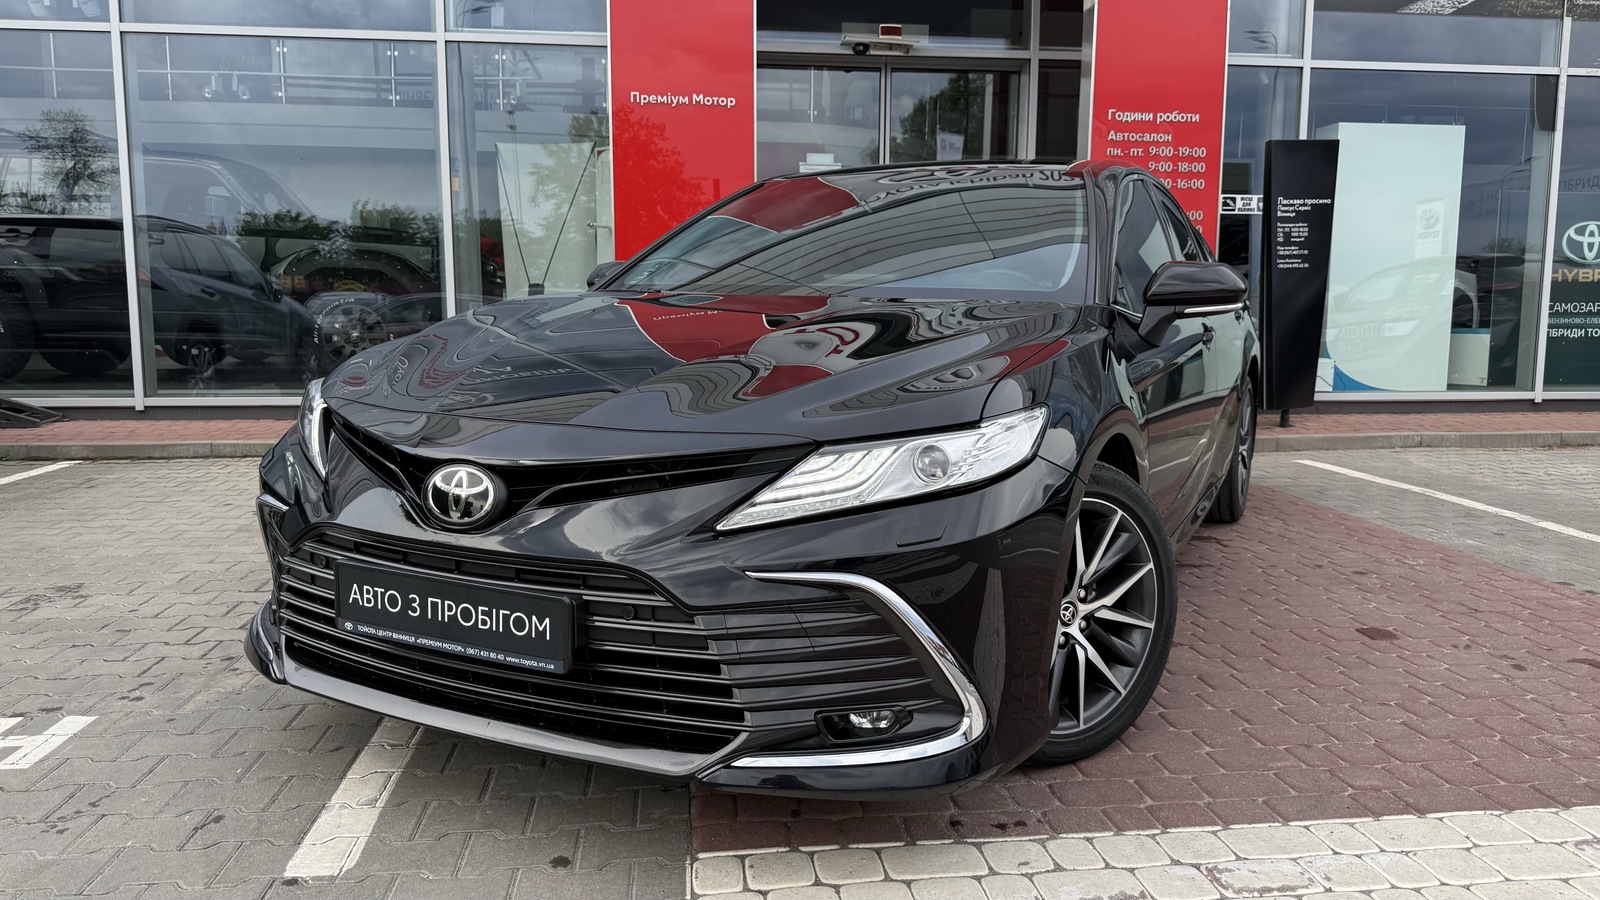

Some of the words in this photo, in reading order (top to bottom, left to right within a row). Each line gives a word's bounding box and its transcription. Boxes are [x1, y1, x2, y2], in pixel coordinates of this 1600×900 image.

[630, 91, 689, 107] Преміум
[692, 93, 736, 108] Мотор
[1107, 108, 1153, 123] Години
[1156, 111, 1200, 124] роботи
[1107, 130, 1172, 142] Автосалон
[1148, 146, 1207, 157] 9:00-19:00
[1148, 161, 1206, 172] 9:00-18:00
[1277, 197, 1304, 205] Ласкаво
[349, 583, 402, 613] АВТО
[408, 594, 420, 616] З
[427, 597, 550, 641] ПРОБІГОМ
[357, 624, 376, 635] ТОЙОТА
[376, 629, 392, 638] ЦЕНТР
[392, 632, 416, 644] ВІННИЦЯ
[466, 647, 480, 656] (067)
[480, 650, 489, 658] 431
[505, 655, 555, 670] www.toyota.vn.ua
